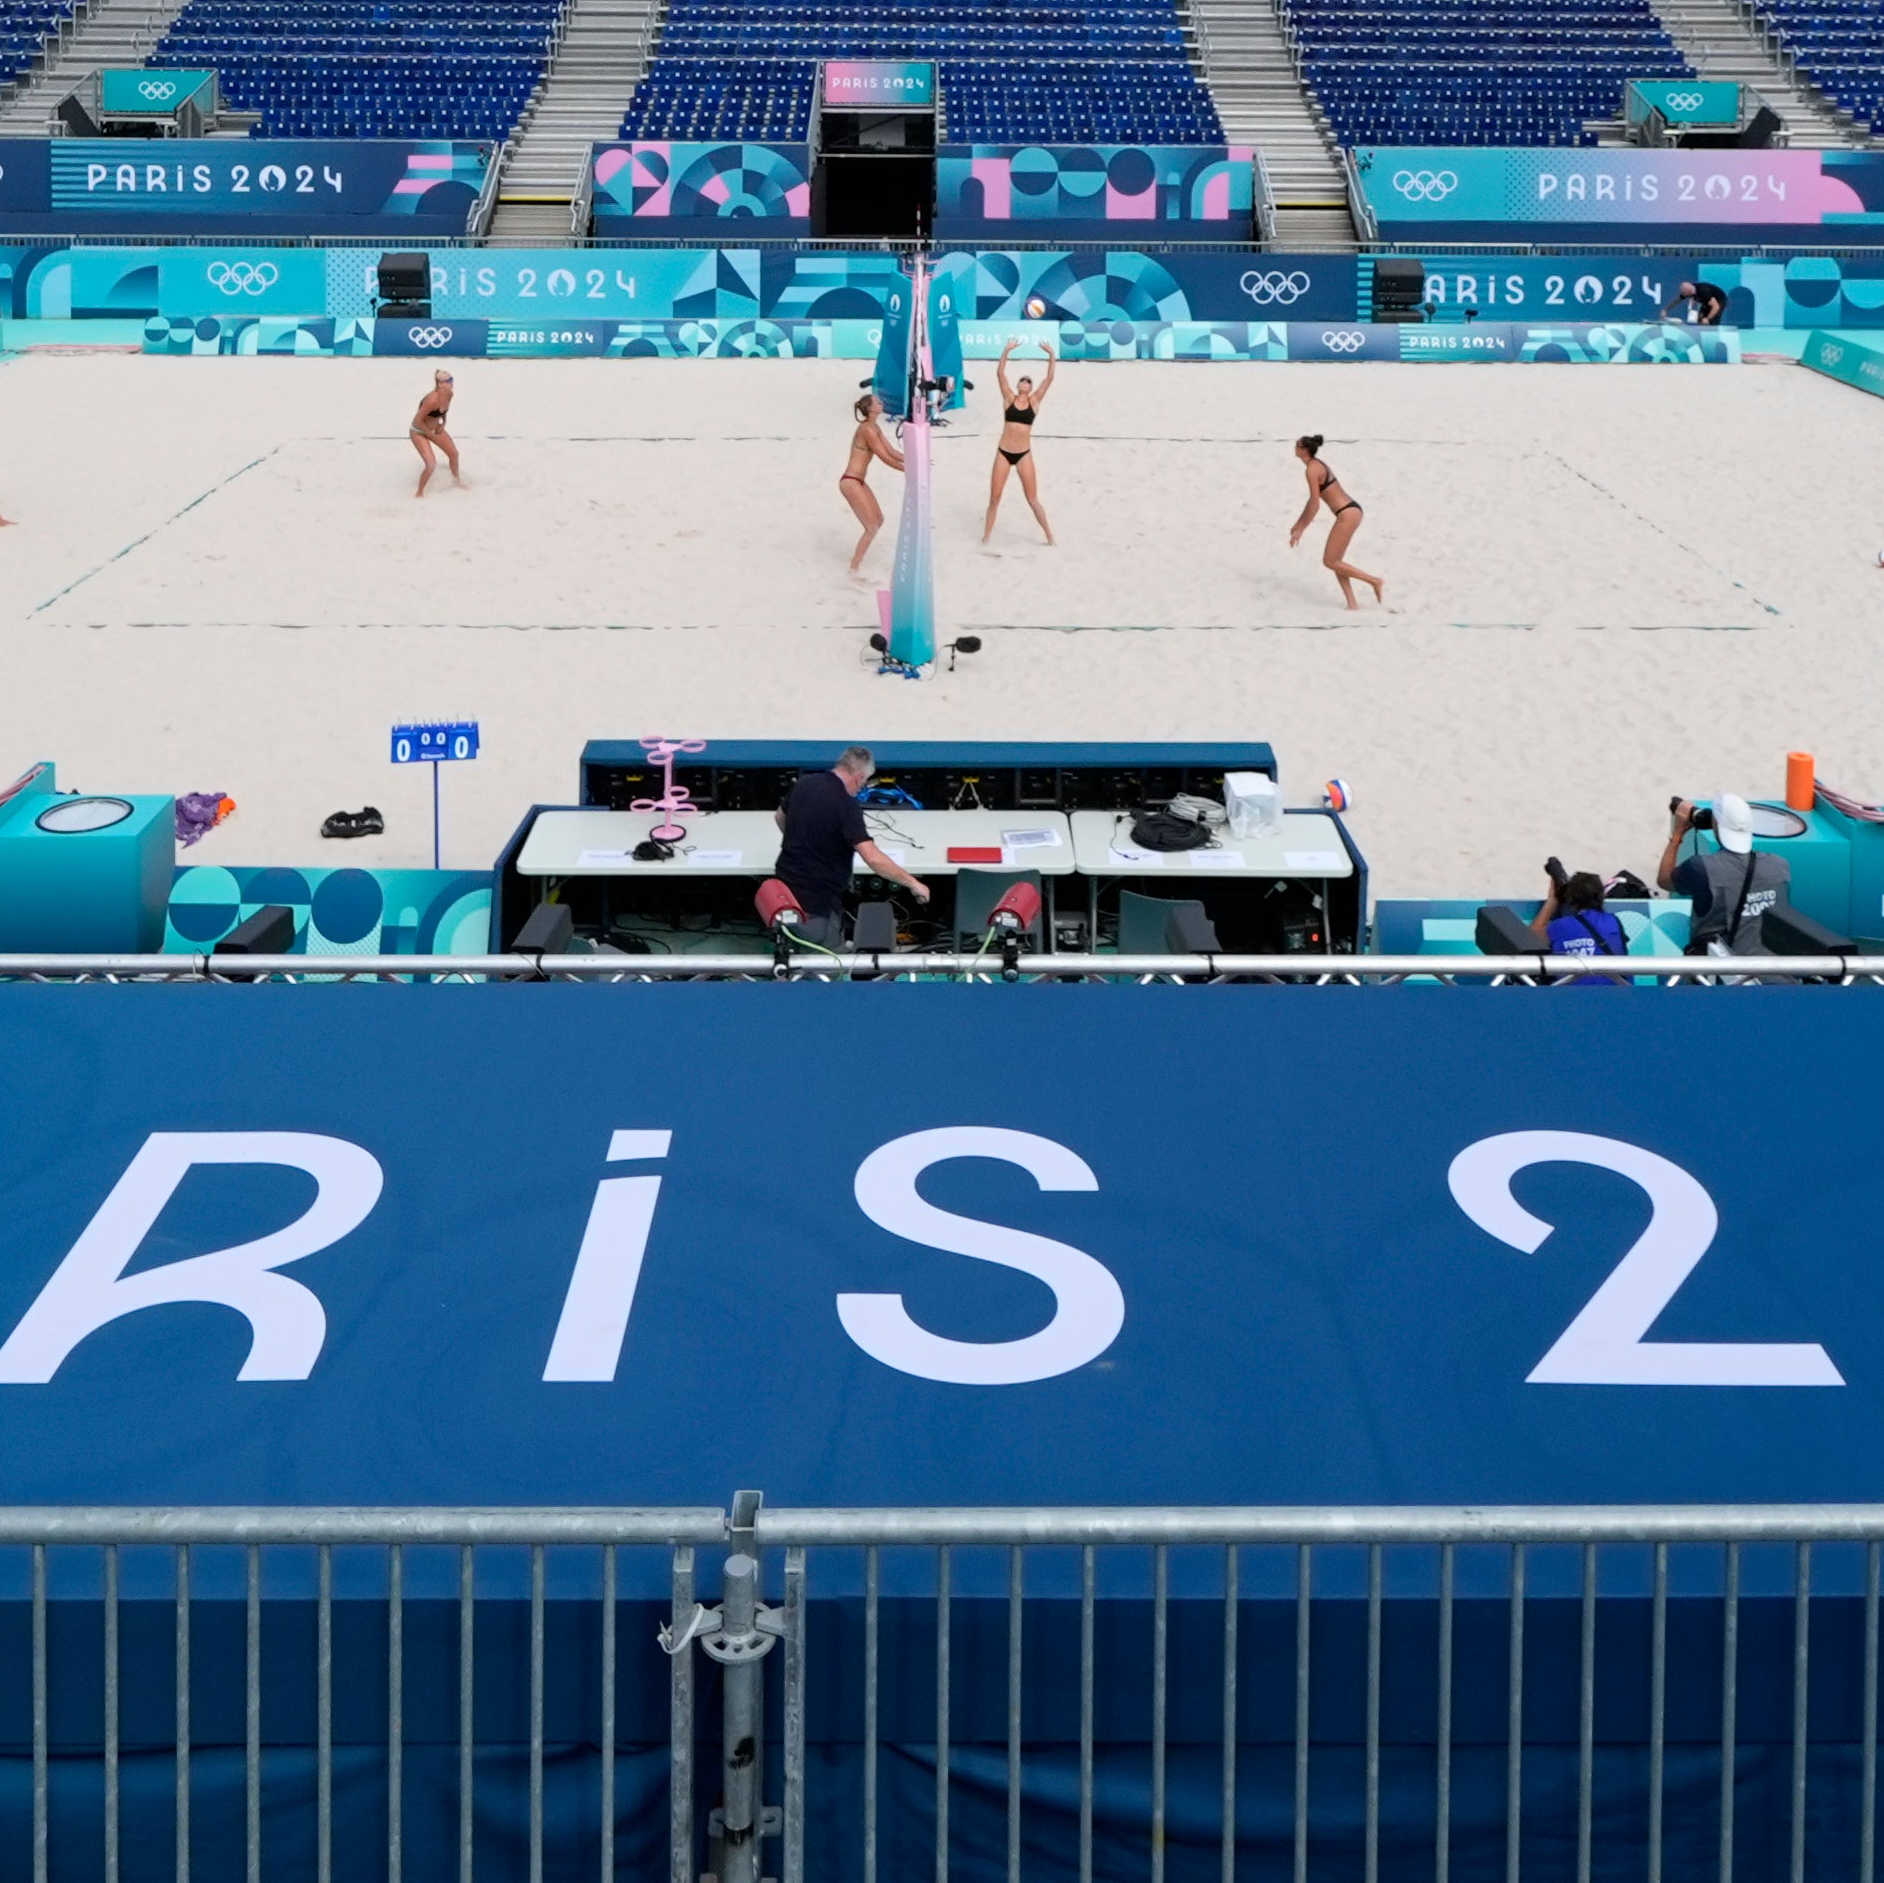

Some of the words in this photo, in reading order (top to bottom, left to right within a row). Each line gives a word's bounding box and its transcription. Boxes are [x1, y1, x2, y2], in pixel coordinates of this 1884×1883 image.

[883, 77, 925, 90] 2024
[231, 165, 342, 193] 2024
[1678, 174, 1785, 201] 2024
[518, 268, 636, 299] 2024
[1545, 275, 1662, 305] 2024
[550, 331, 594, 344] 2024
[1462, 336, 1505, 349] 2024
[397, 739, 411, 762] 0
[421, 733, 431, 746] 0
[436, 732, 446, 746] 0
[455, 736, 469, 759] 0
